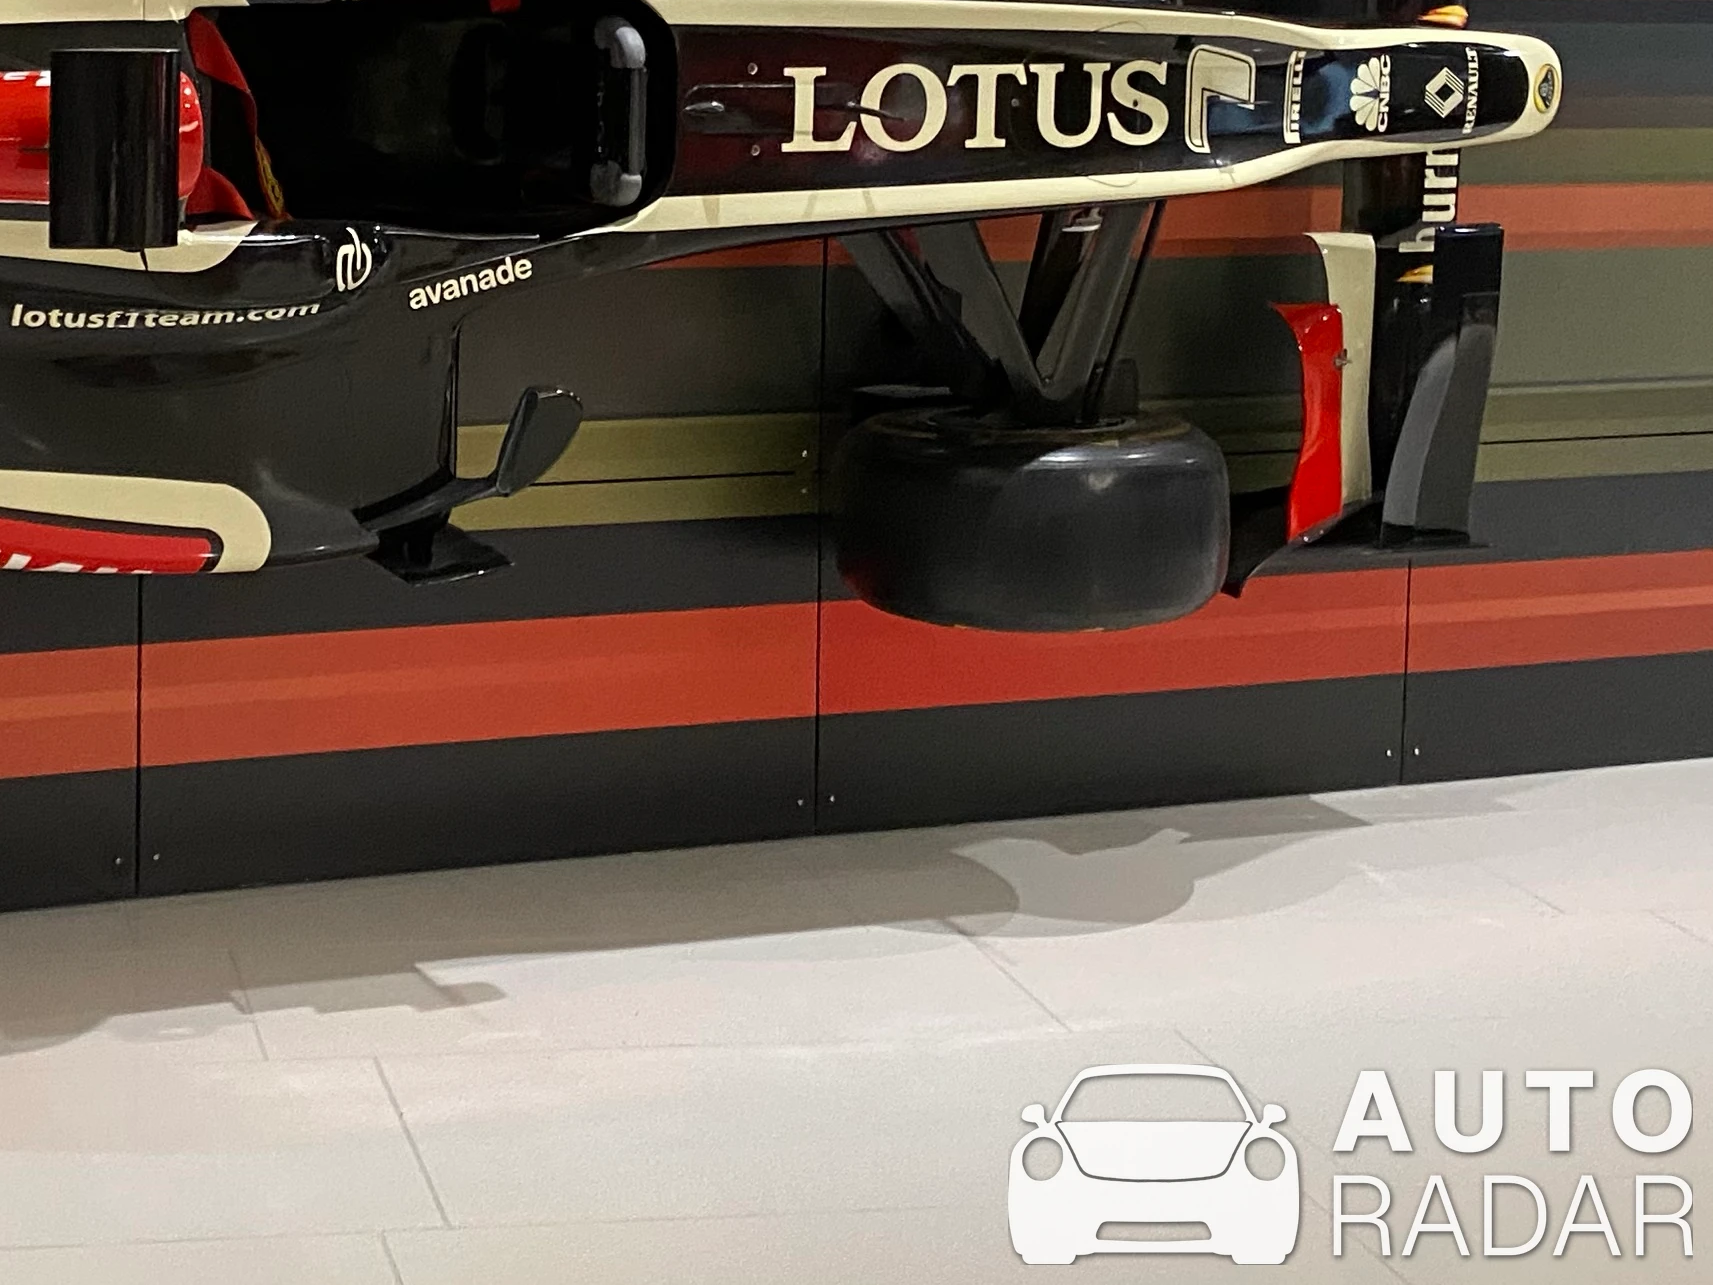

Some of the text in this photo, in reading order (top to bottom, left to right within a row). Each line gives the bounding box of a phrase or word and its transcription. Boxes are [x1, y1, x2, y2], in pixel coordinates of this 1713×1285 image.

[782, 59, 1168, 154] LOTUS
[1377, 54, 1391, 133] CNBC
[1462, 46, 1479, 134] RENAULT
[11, 303, 320, 329] lotusf1team.com
[408, 256, 533, 310] avanade
